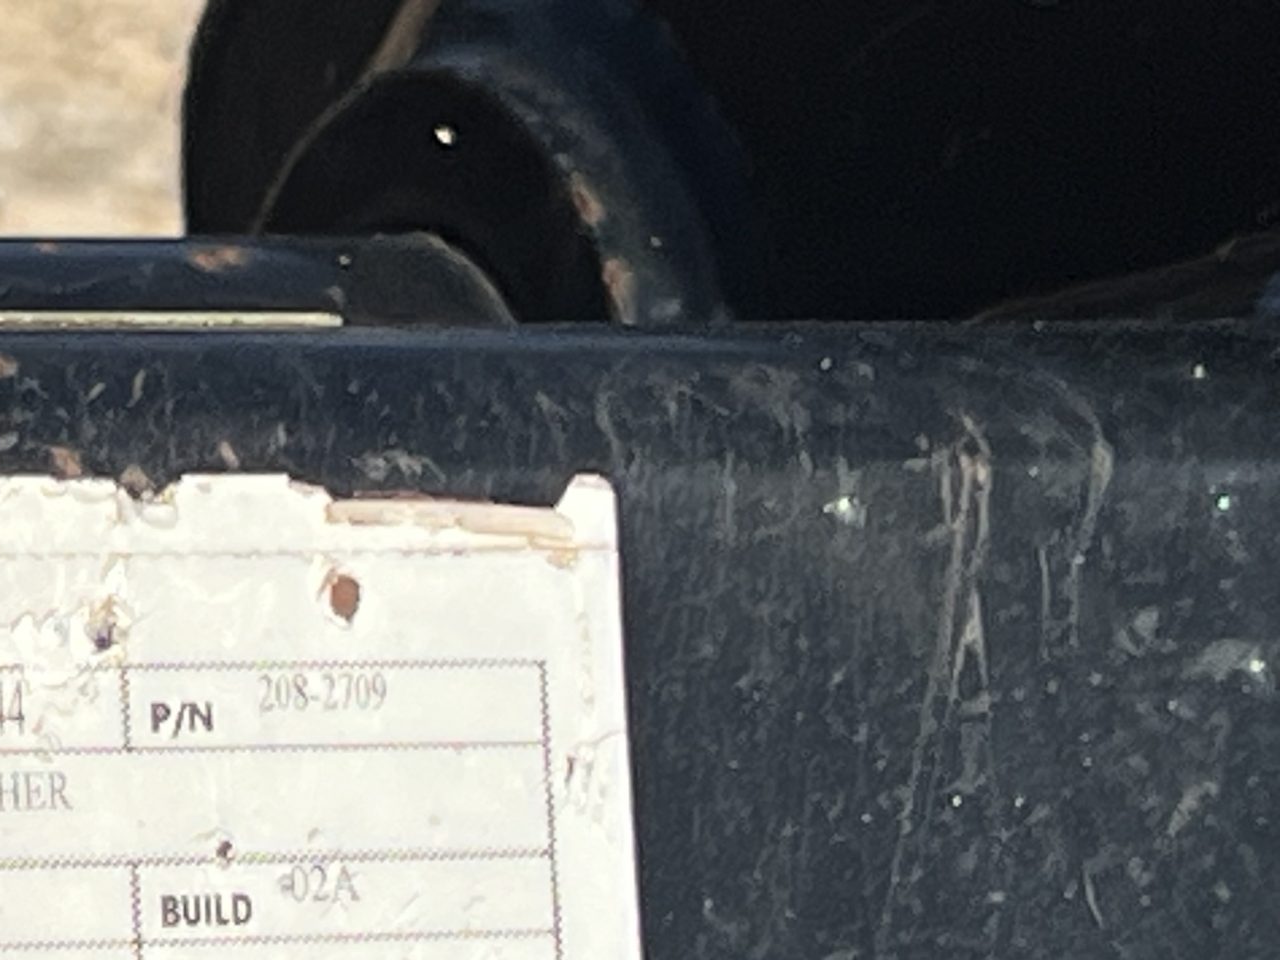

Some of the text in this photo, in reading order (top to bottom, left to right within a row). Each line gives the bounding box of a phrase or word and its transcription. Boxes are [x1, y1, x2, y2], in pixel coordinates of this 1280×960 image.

[258, 672, 388, 713] 208-2709
[150, 701, 215, 738] P/N
[161, 894, 253, 928] BUILD
